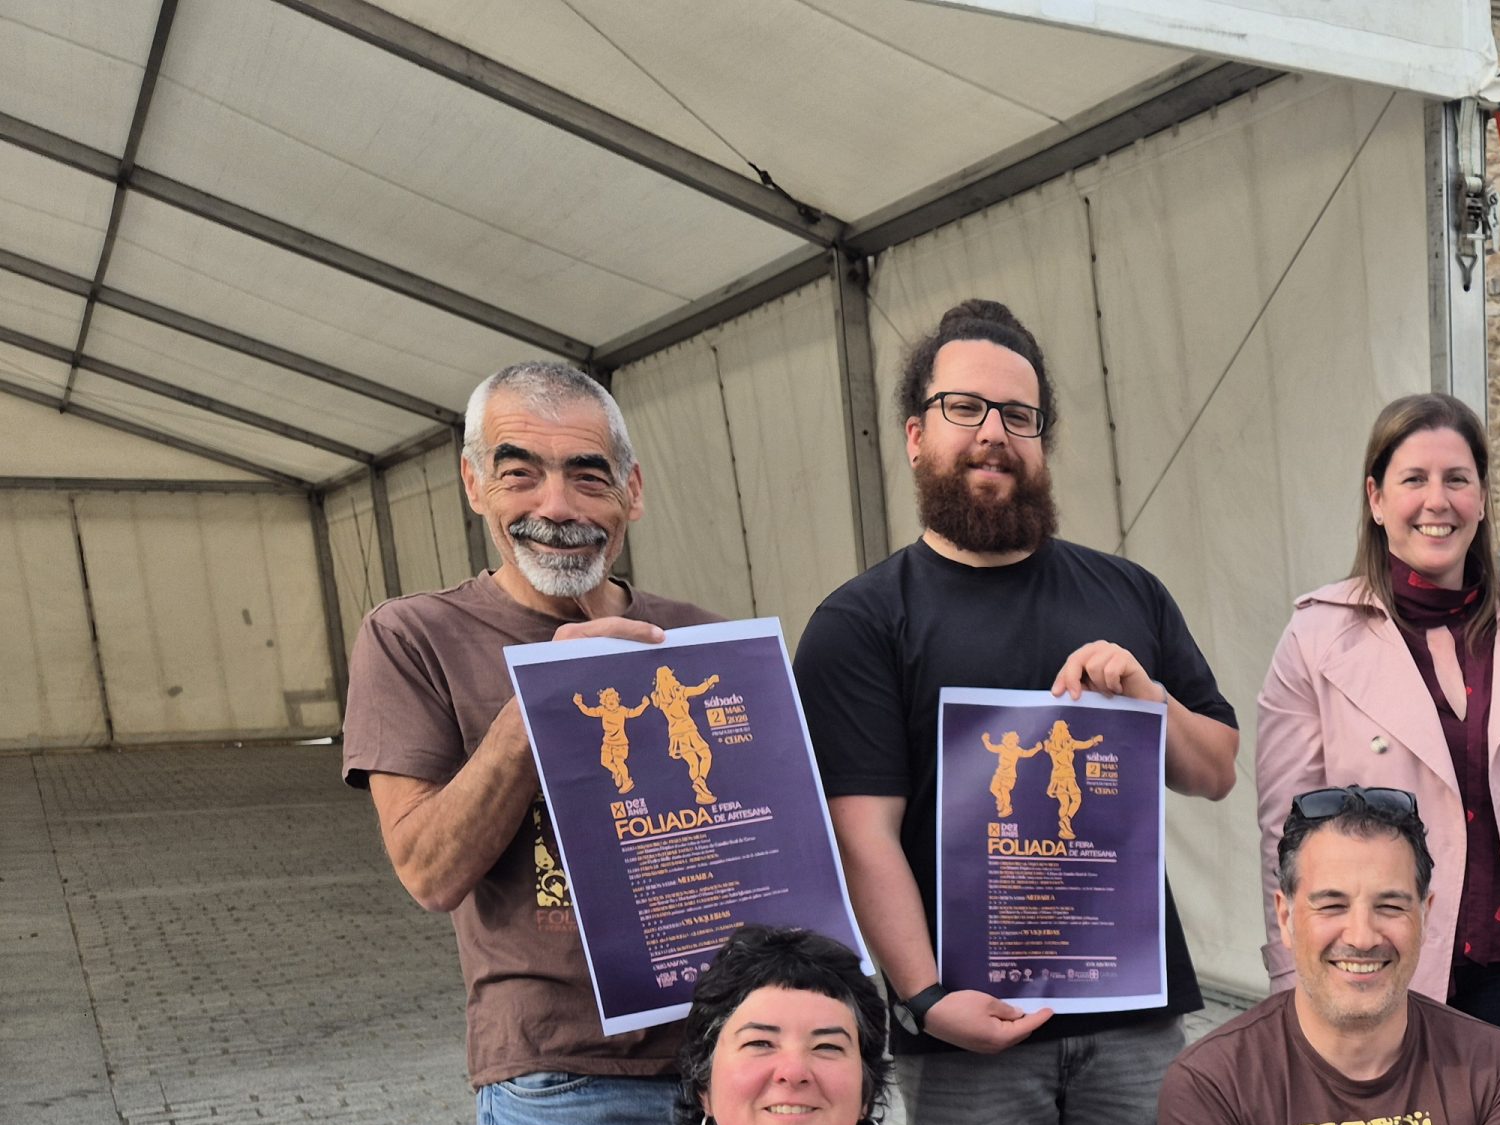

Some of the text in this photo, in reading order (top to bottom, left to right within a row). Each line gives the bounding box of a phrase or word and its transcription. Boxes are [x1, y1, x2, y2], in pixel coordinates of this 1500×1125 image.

[711, 801, 742, 814] E FEIRA
[614, 807, 714, 840] FOLIADA
[713, 814, 726, 823] DE
[988, 838, 1068, 856] FOLIADA
[1075, 841, 1095, 849] FEIRA
